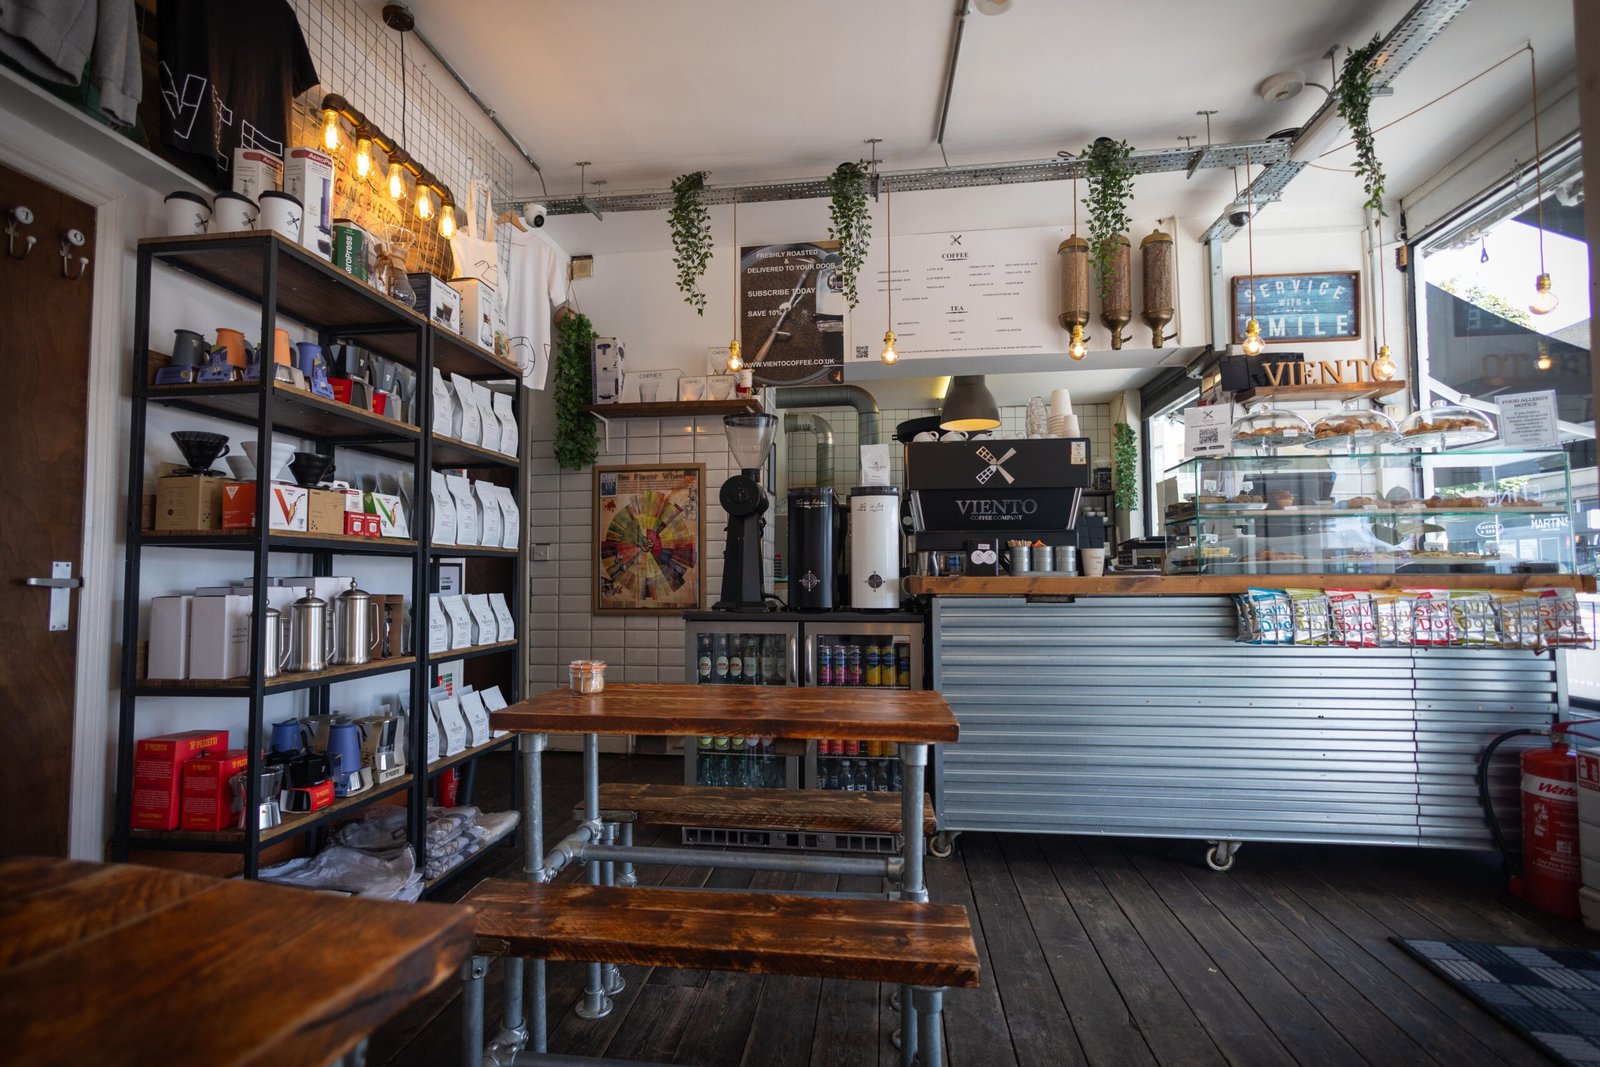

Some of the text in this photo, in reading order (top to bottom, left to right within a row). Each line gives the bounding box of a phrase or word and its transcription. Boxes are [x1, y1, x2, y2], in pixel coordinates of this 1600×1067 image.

[756, 249, 818, 259] FRESHLY ROASTED
[747, 265, 784, 274] DELIVERED
[747, 287, 816, 297] SUBSCRIBE TODAY
[1244, 278, 1346, 303] SERVICE
[1278, 298, 1301, 307] WITH
[747, 310, 766, 318] SAVE
[955, 499, 1038, 515] VIENTO
[1531, 516, 1569, 529] MARTINS
